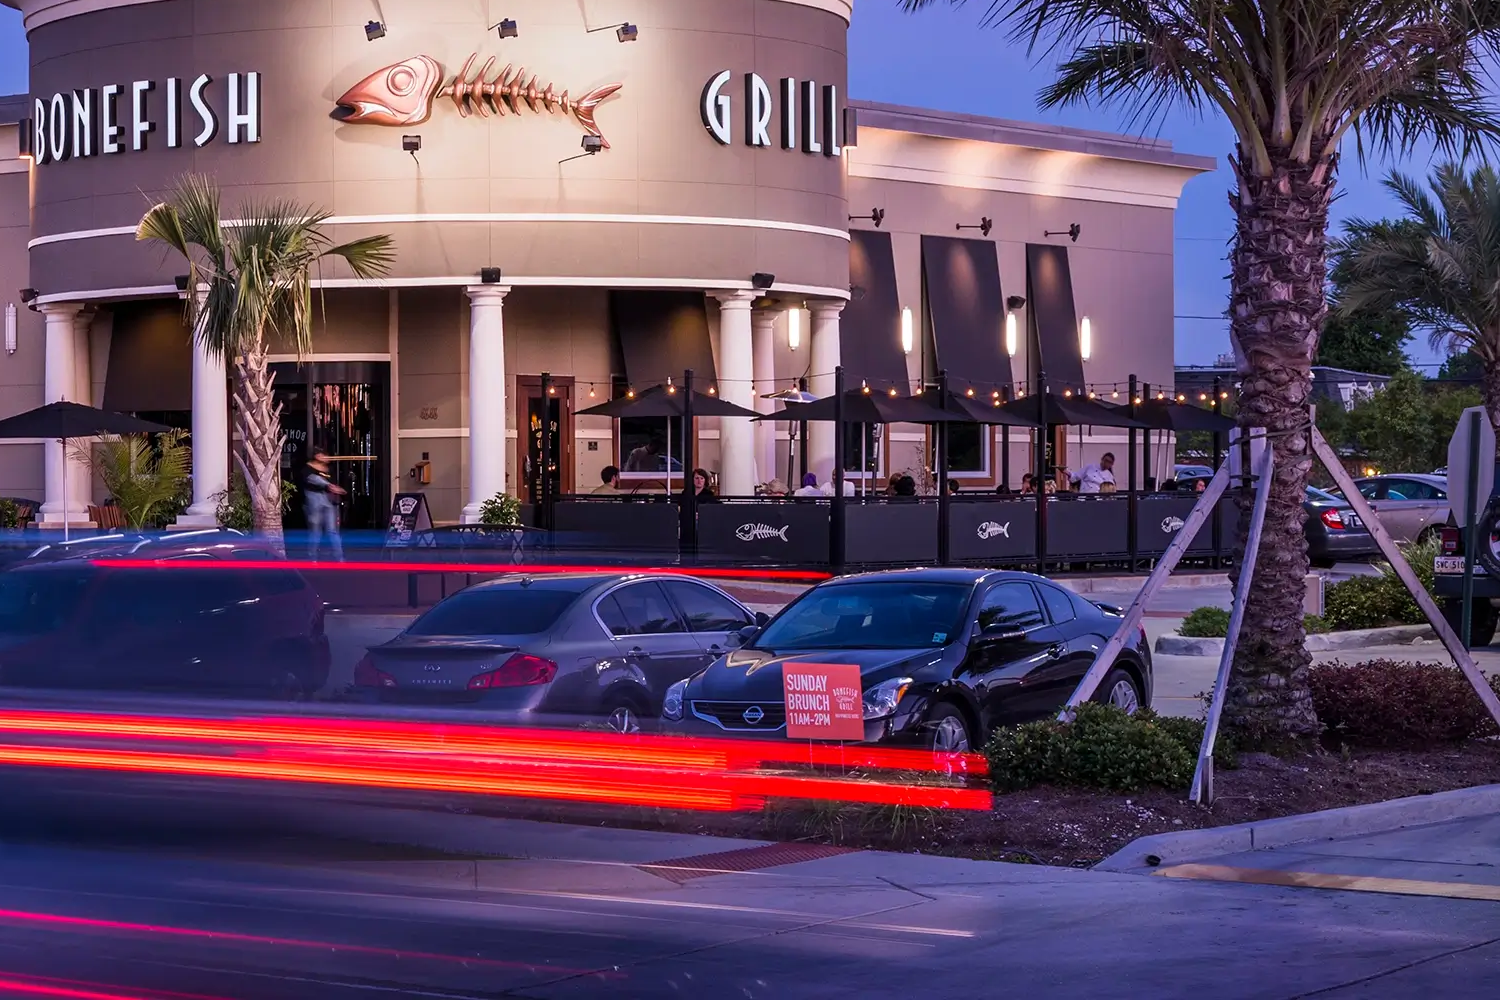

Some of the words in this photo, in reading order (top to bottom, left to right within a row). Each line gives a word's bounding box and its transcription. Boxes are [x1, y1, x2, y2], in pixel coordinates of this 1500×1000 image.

[35, 71, 261, 166] BONEFISH
[700, 70, 841, 157] GRILL
[787, 674, 827, 691] SUNDAY
[788, 694, 830, 711] BRUNCH
[789, 712, 831, 726] 11AM-2PM
